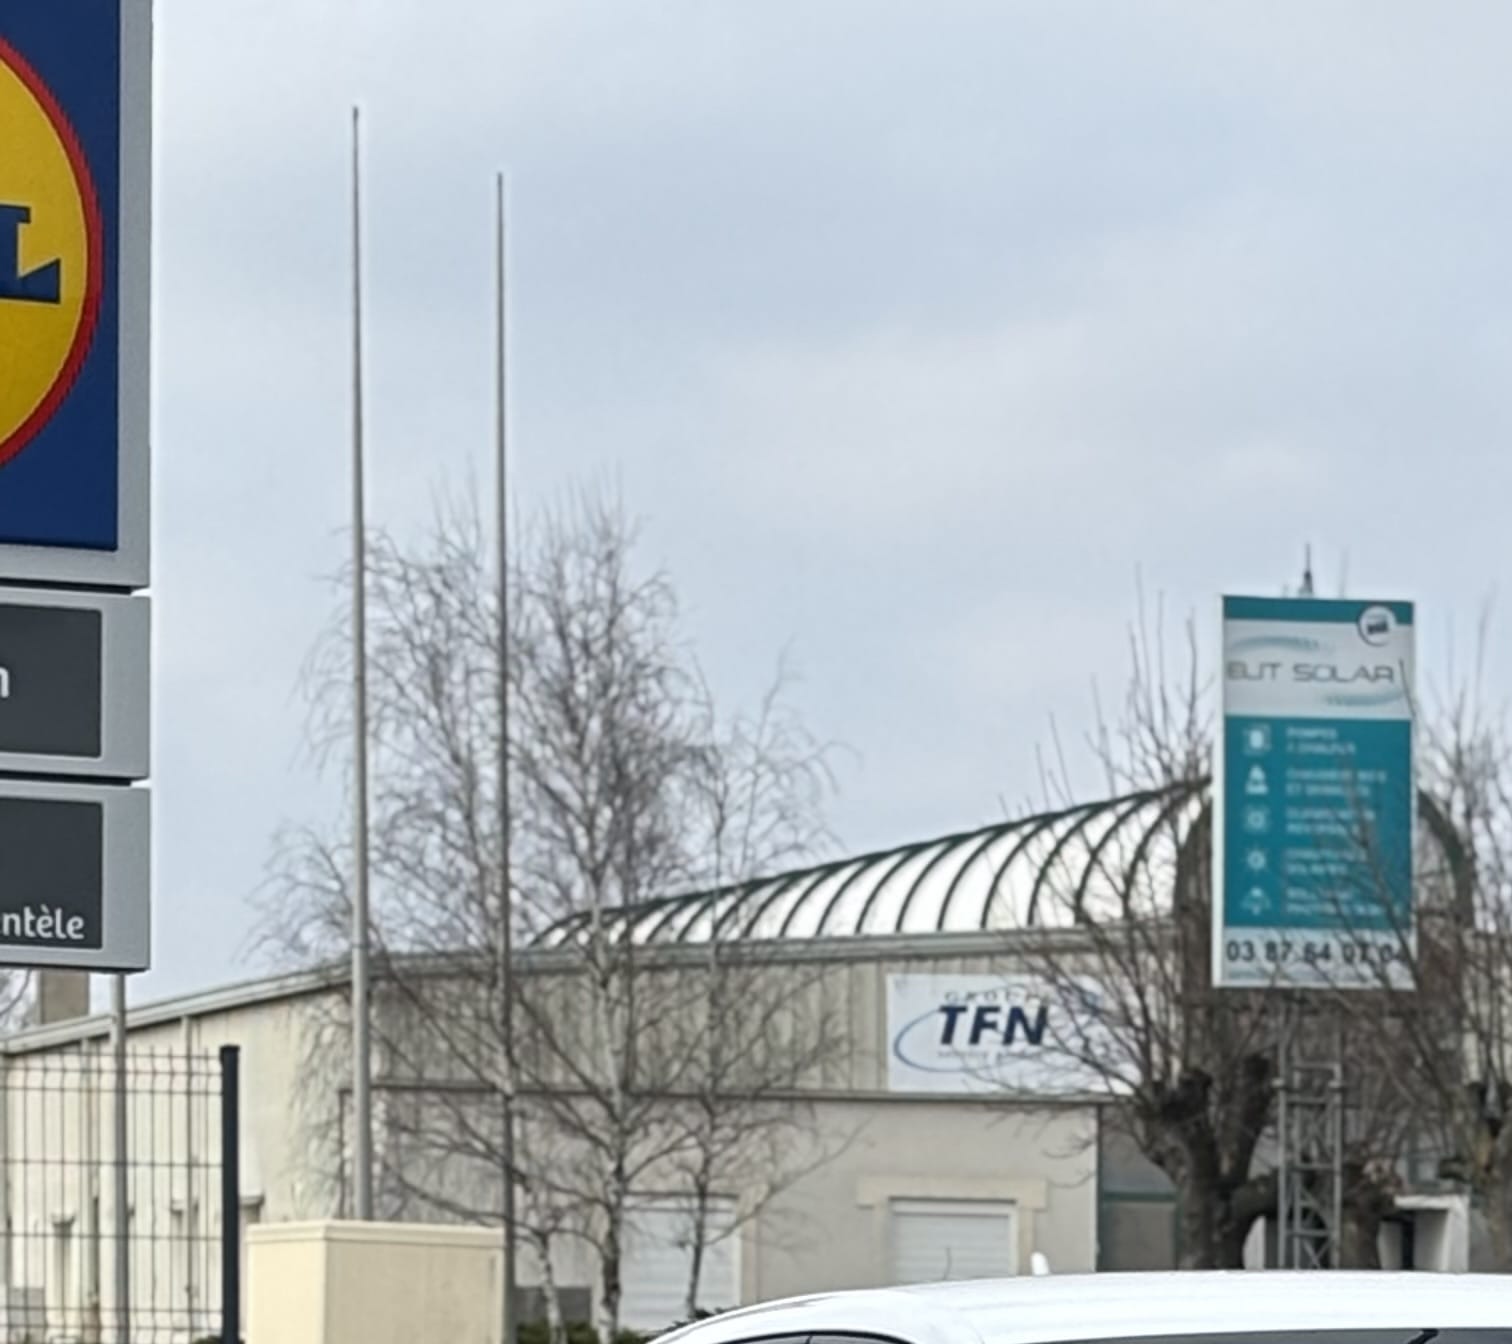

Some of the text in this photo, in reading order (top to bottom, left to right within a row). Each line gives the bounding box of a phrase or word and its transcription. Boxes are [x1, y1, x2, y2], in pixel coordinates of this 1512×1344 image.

[1292, 663, 1394, 684] SOLAR
[1226, 940, 1255, 961] 03
[940, 1006, 1048, 1045] TFN
